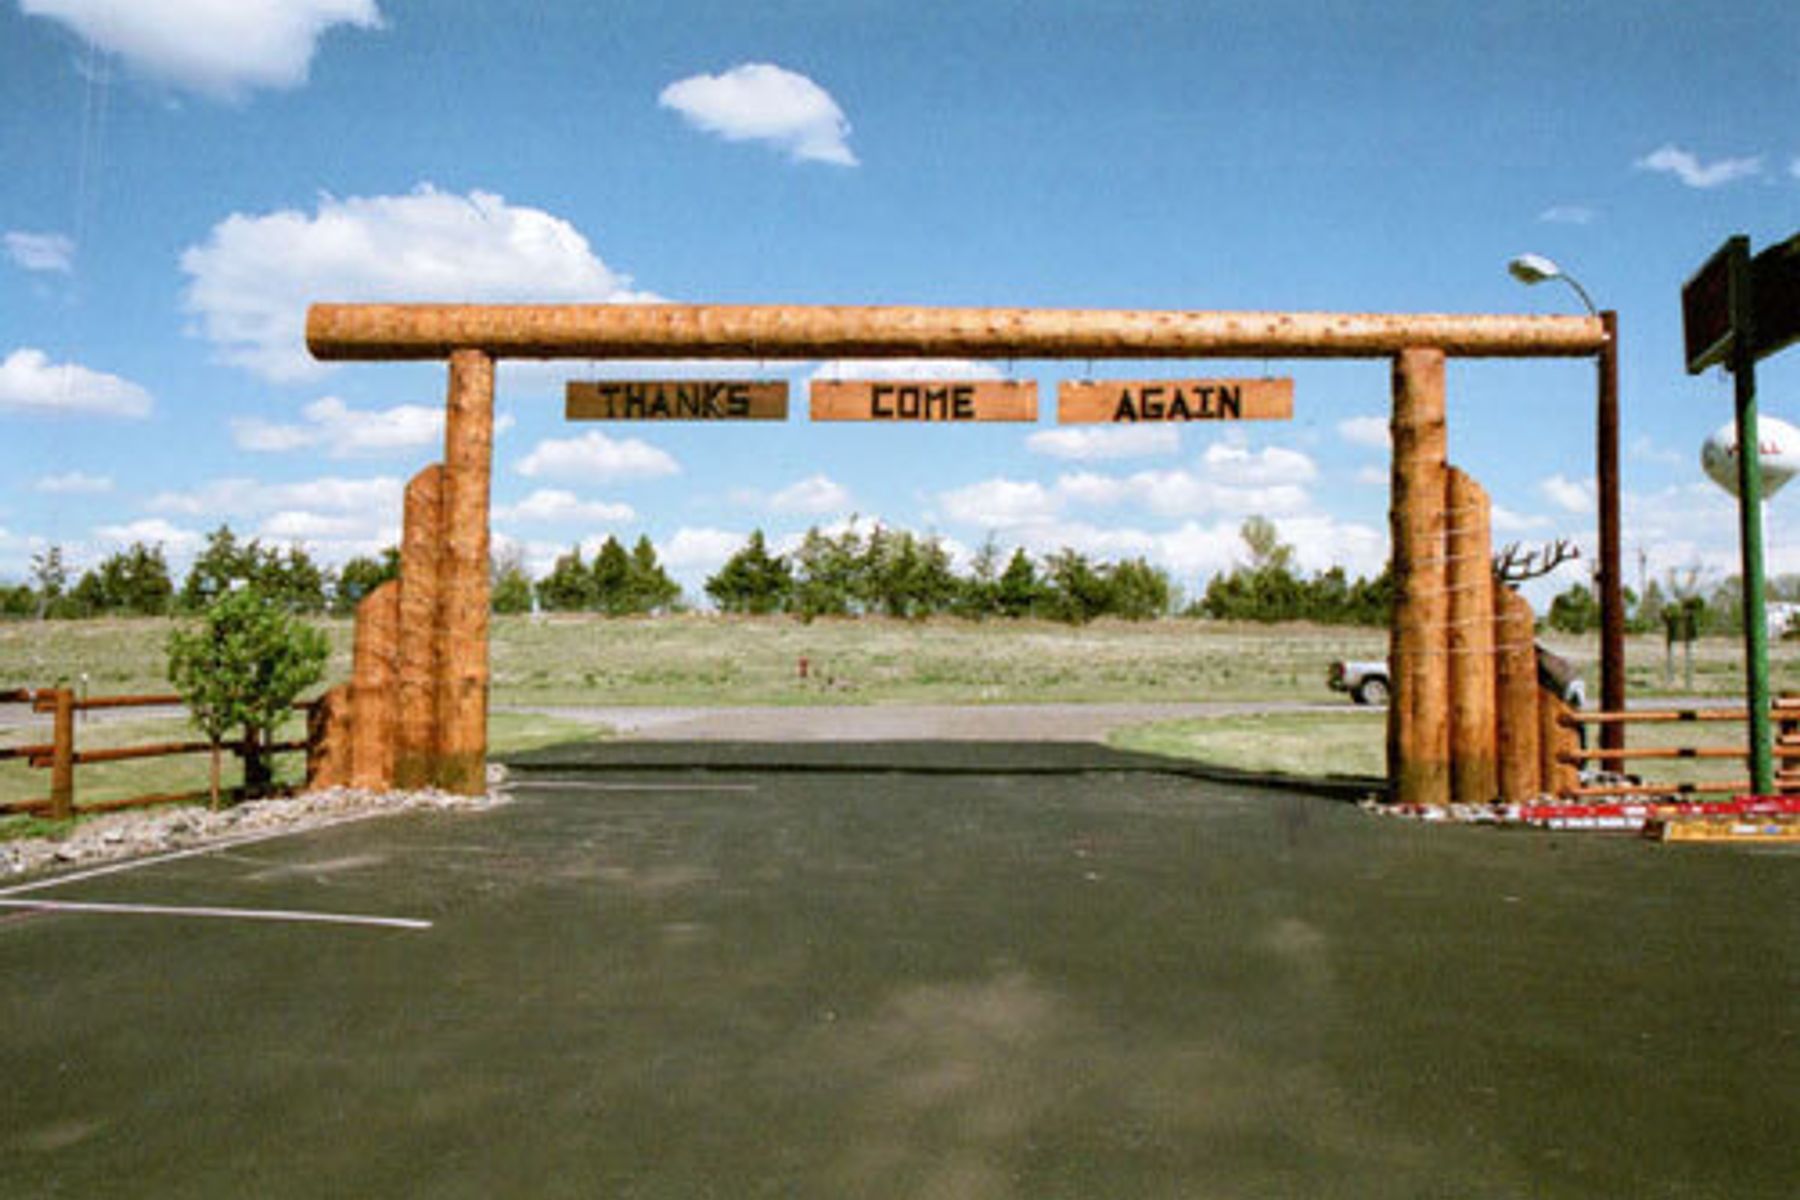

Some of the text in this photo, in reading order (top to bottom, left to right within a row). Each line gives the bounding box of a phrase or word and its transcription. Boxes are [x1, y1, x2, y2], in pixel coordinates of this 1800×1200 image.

[597, 383, 1241, 422] THANKS COME AGAIN
